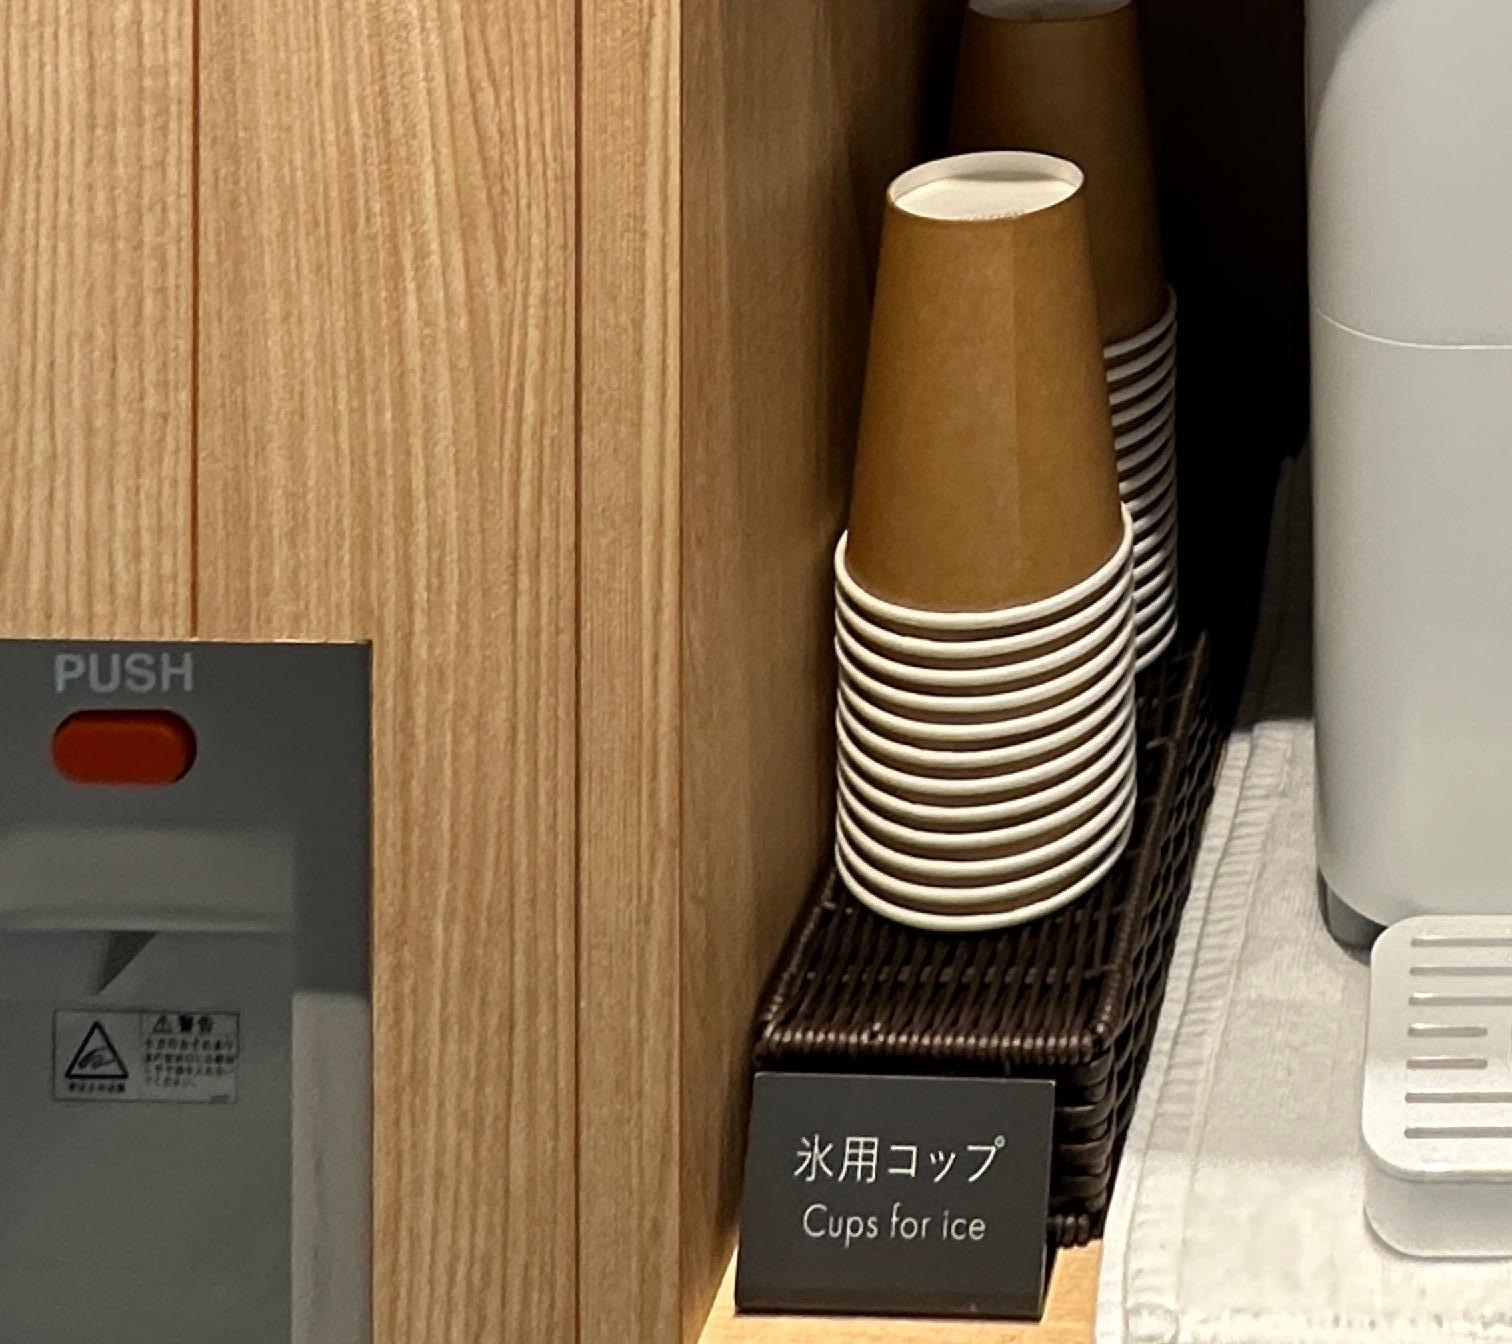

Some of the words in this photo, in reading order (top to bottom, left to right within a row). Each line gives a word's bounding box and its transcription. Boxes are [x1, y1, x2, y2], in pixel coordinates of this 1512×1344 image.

[52, 652, 195, 694] PUSH
[793, 1132, 1006, 1185] 氷用コップ
[802, 1202, 879, 1248] Cups
[889, 1201, 932, 1240] for
[942, 1209, 987, 1242] ice
